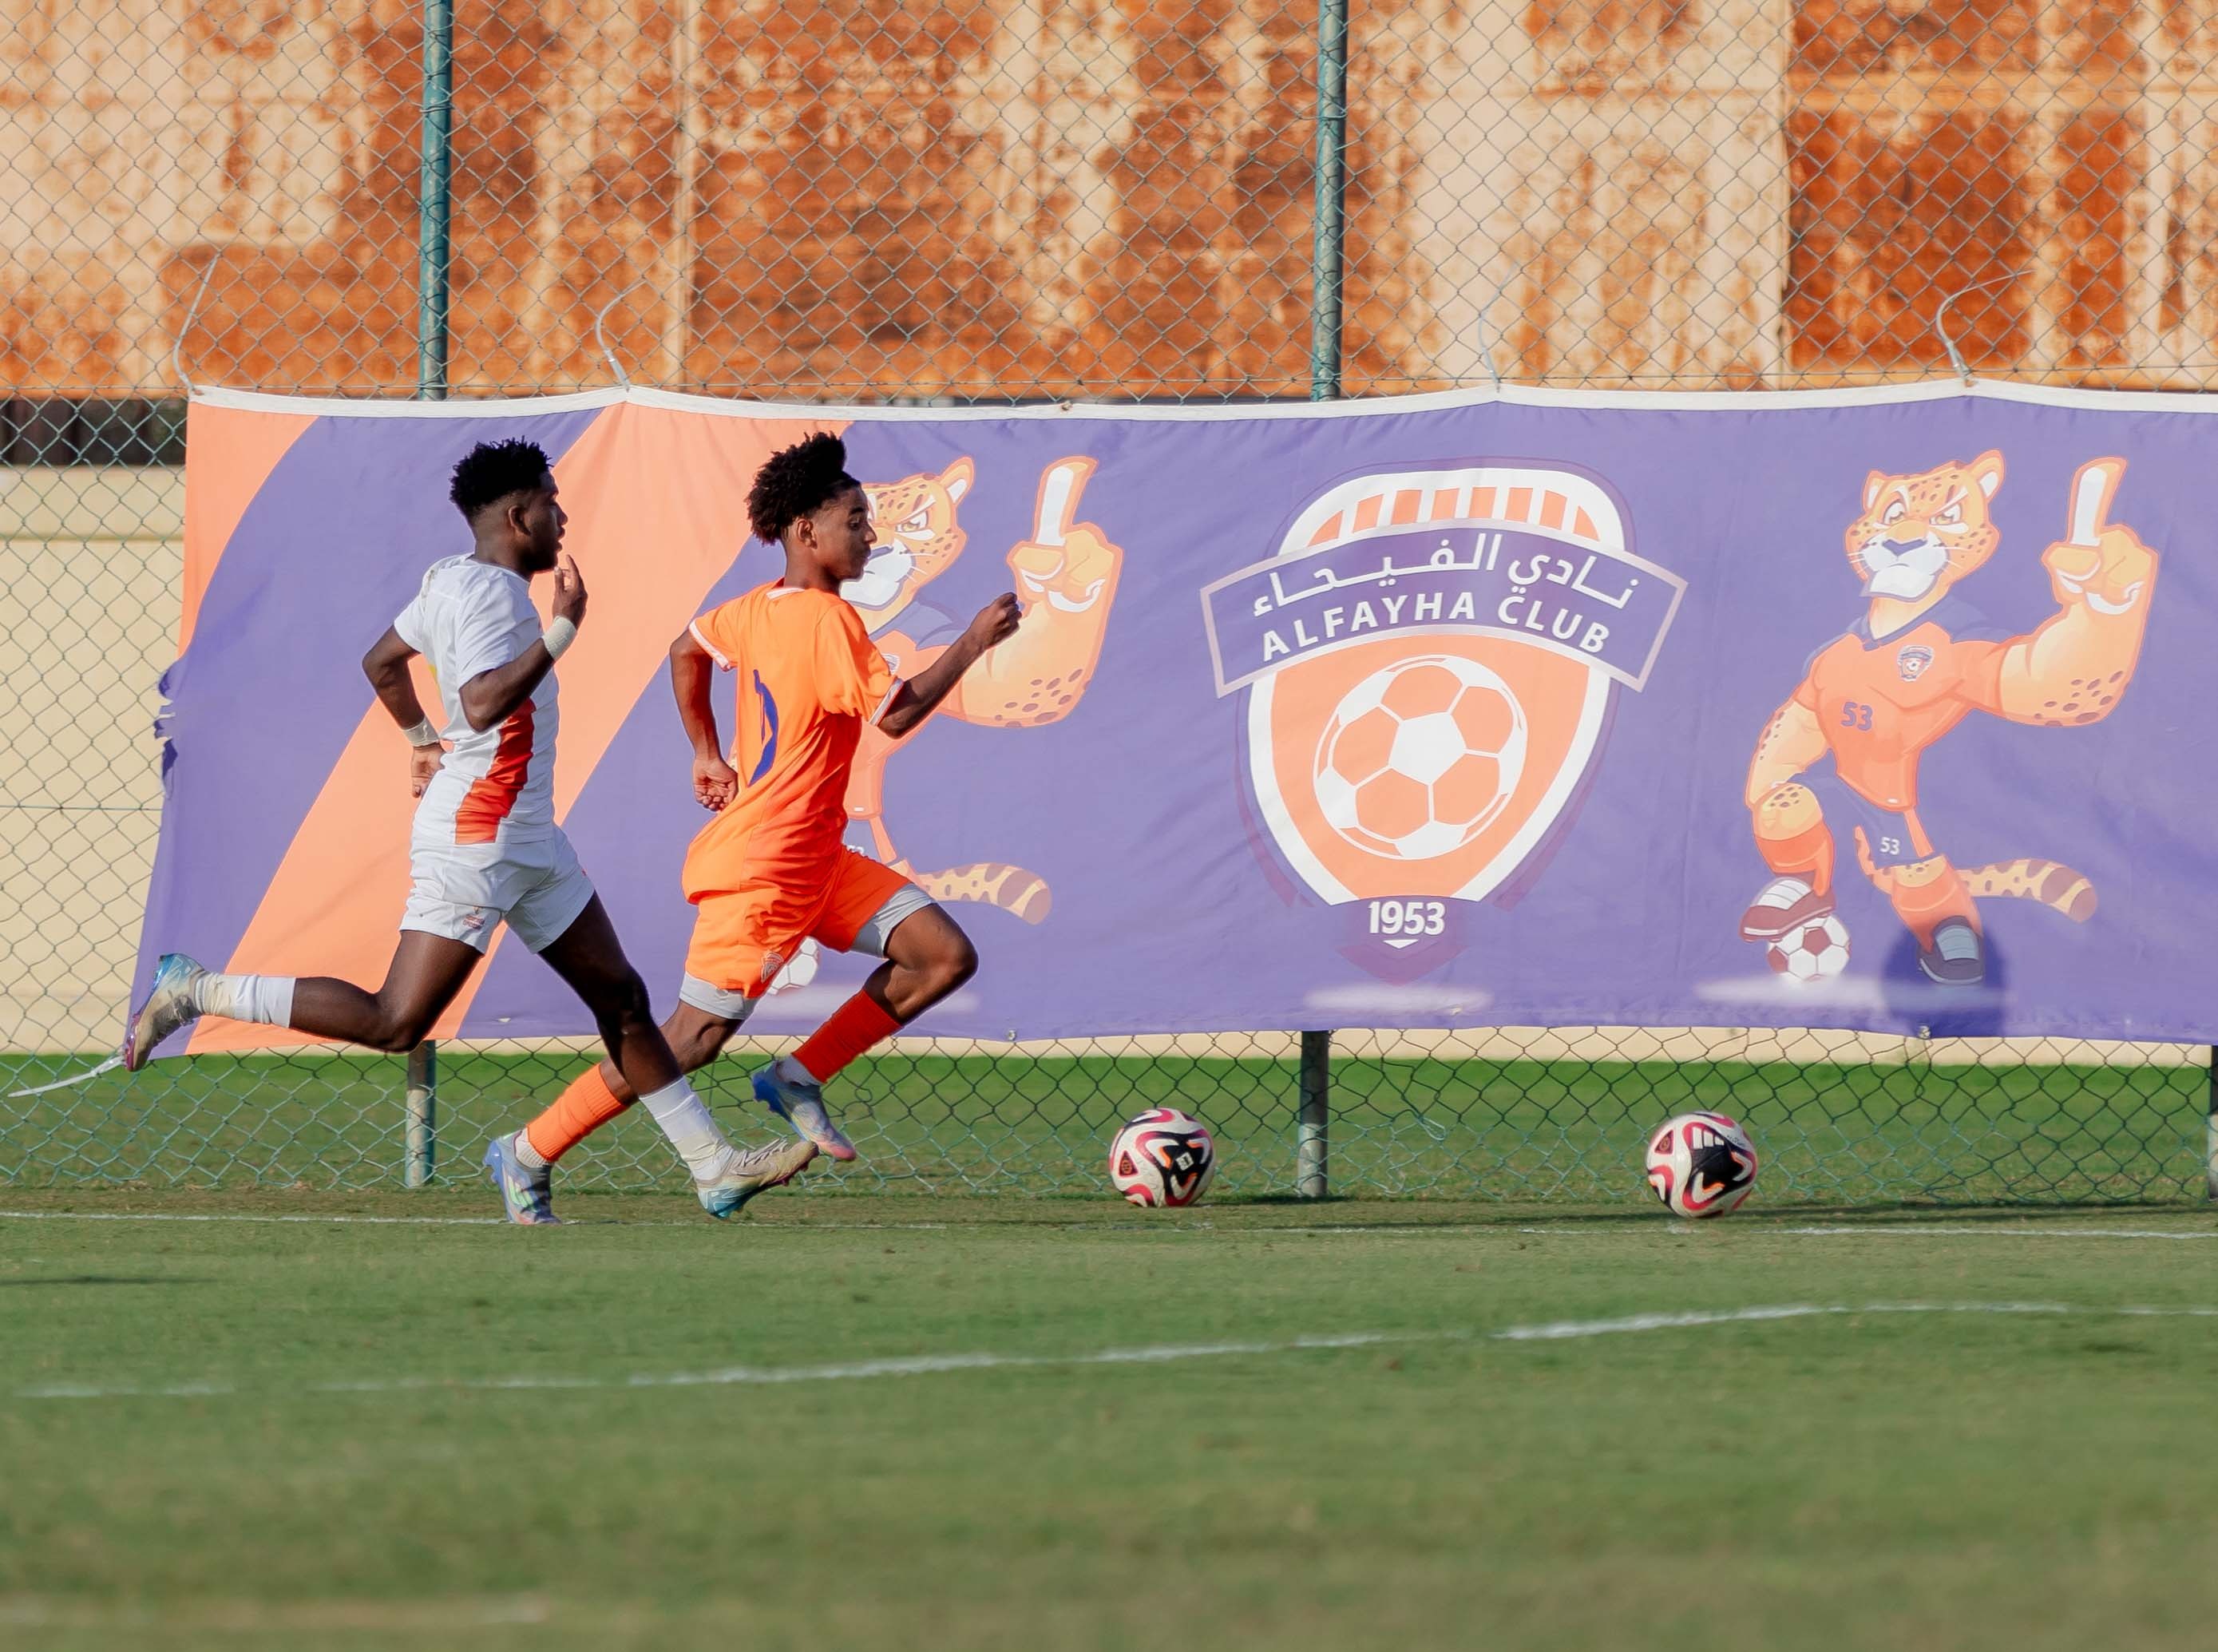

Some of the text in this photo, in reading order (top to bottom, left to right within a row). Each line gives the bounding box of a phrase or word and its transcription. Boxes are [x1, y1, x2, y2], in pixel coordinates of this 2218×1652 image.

[1254, 533, 1639, 617] نادي الفيحاء
[1262, 592, 1611, 662] ALFAYHA CLUB
[1840, 701, 1872, 731] 53
[1879, 836, 1900, 854] 53
[1368, 901, 1445, 935] 1953
